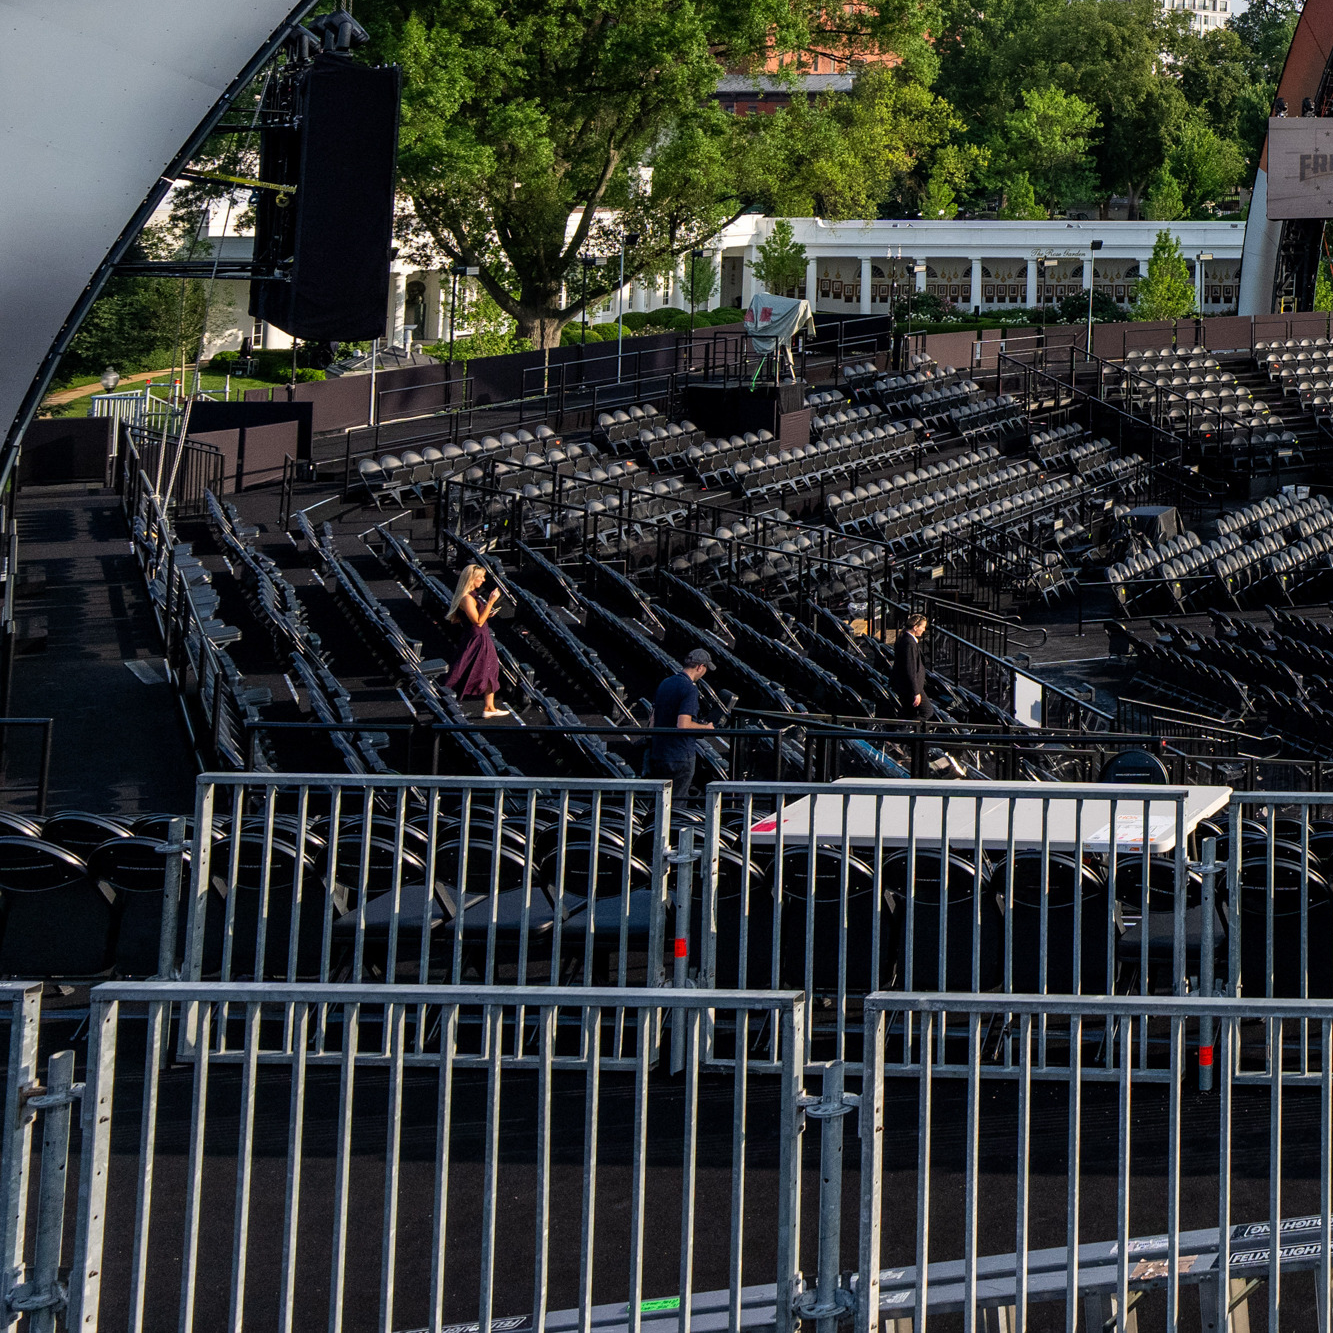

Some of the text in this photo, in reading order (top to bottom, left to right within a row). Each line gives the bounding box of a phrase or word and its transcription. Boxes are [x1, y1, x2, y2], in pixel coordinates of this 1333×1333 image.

[1031, 248, 1086, 257] The Rose Garden
[1232, 1250, 1271, 1264] FELIX
[491, 1319, 520, 1329] FELI
